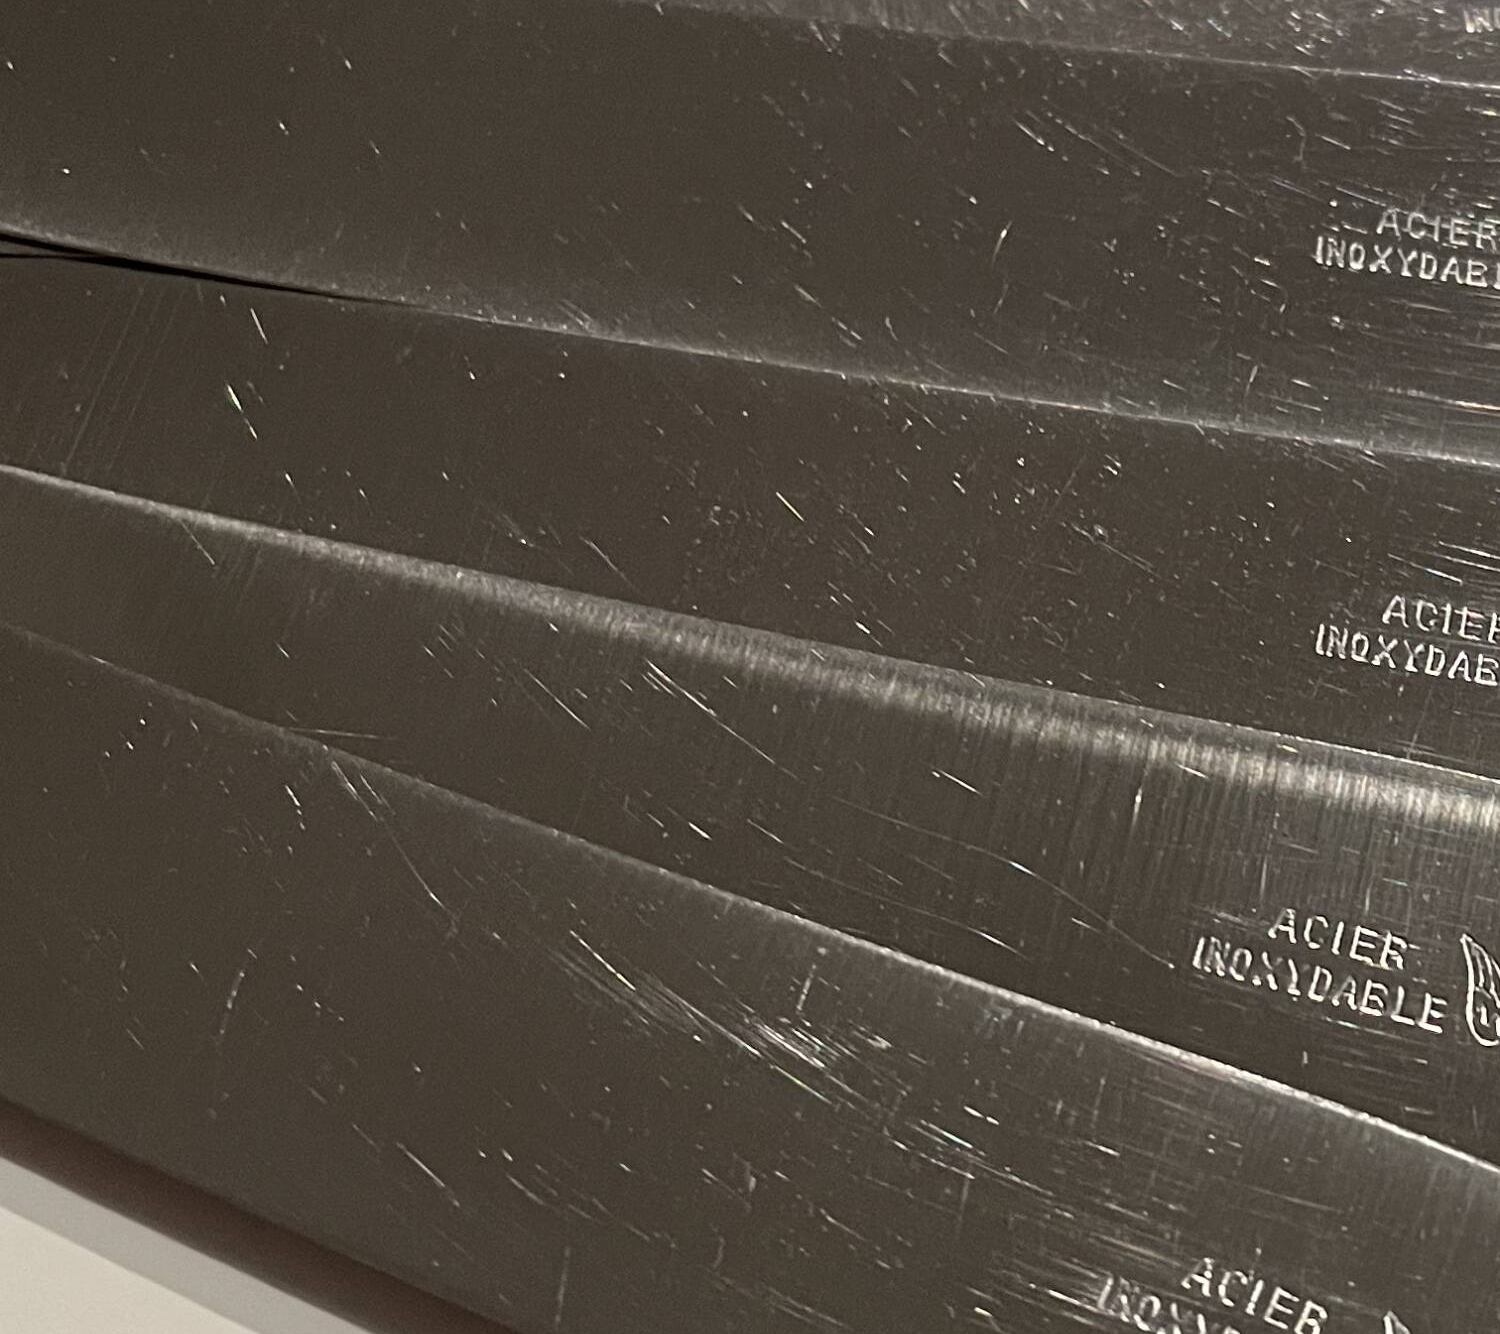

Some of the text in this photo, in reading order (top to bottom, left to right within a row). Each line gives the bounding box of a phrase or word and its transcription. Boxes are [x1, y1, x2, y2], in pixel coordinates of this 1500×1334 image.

[1377, 207, 1499, 252] ACIER
[1267, 908, 1408, 970] ACIER
[1191, 936, 1449, 1034] INOXYDABLE
